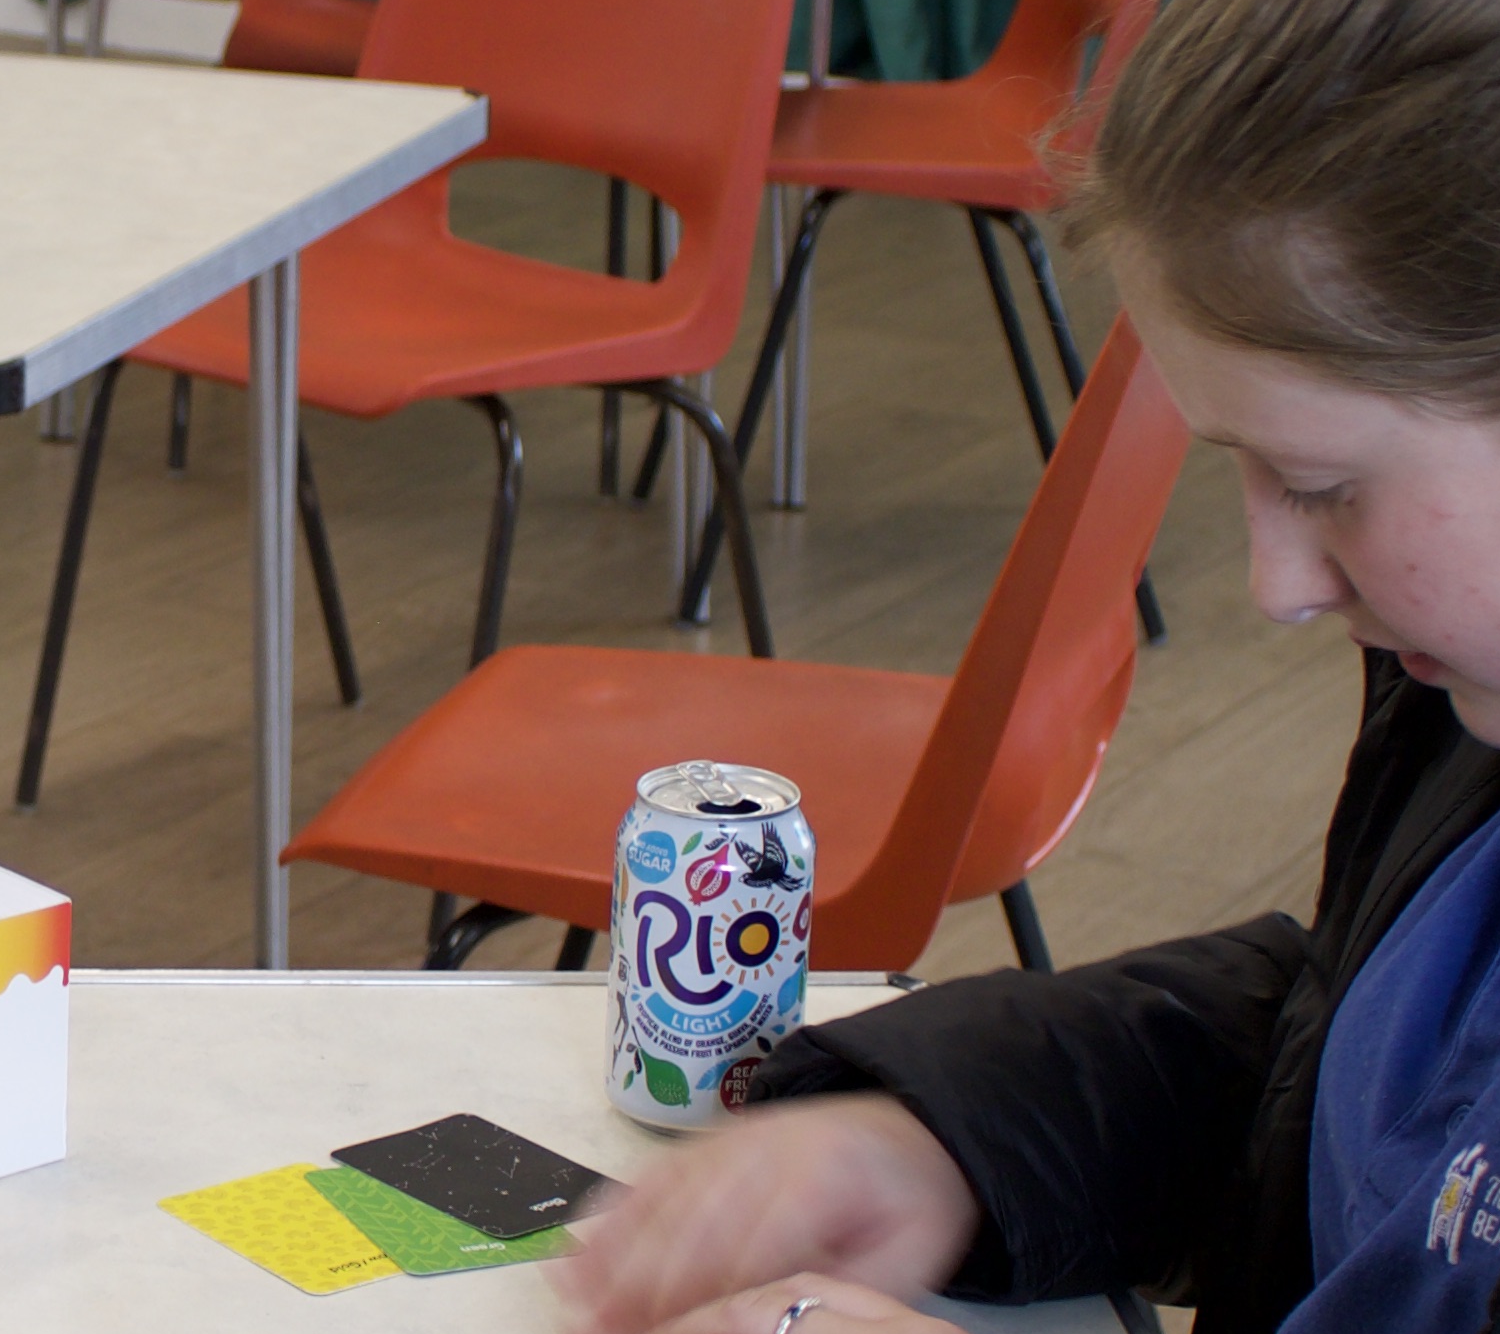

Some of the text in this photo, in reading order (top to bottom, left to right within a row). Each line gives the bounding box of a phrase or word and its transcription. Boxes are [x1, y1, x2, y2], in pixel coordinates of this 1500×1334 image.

[628, 848, 672, 874] SUGAR
[633, 889, 781, 1007] RIO
[635, 1016, 654, 1040] MANGO
[659, 1039, 690, 1058] PASSION
[691, 1049, 713, 1059] FRUIT
[637, 1003, 660, 1034] TROPICAL
[660, 1027, 683, 1045] BLEND
[683, 1037, 693, 1047] OF
[695, 1035, 728, 1048] ORANGE,
[671, 1010, 735, 1034] LIGHT
[460, 1242, 507, 1253] Green
